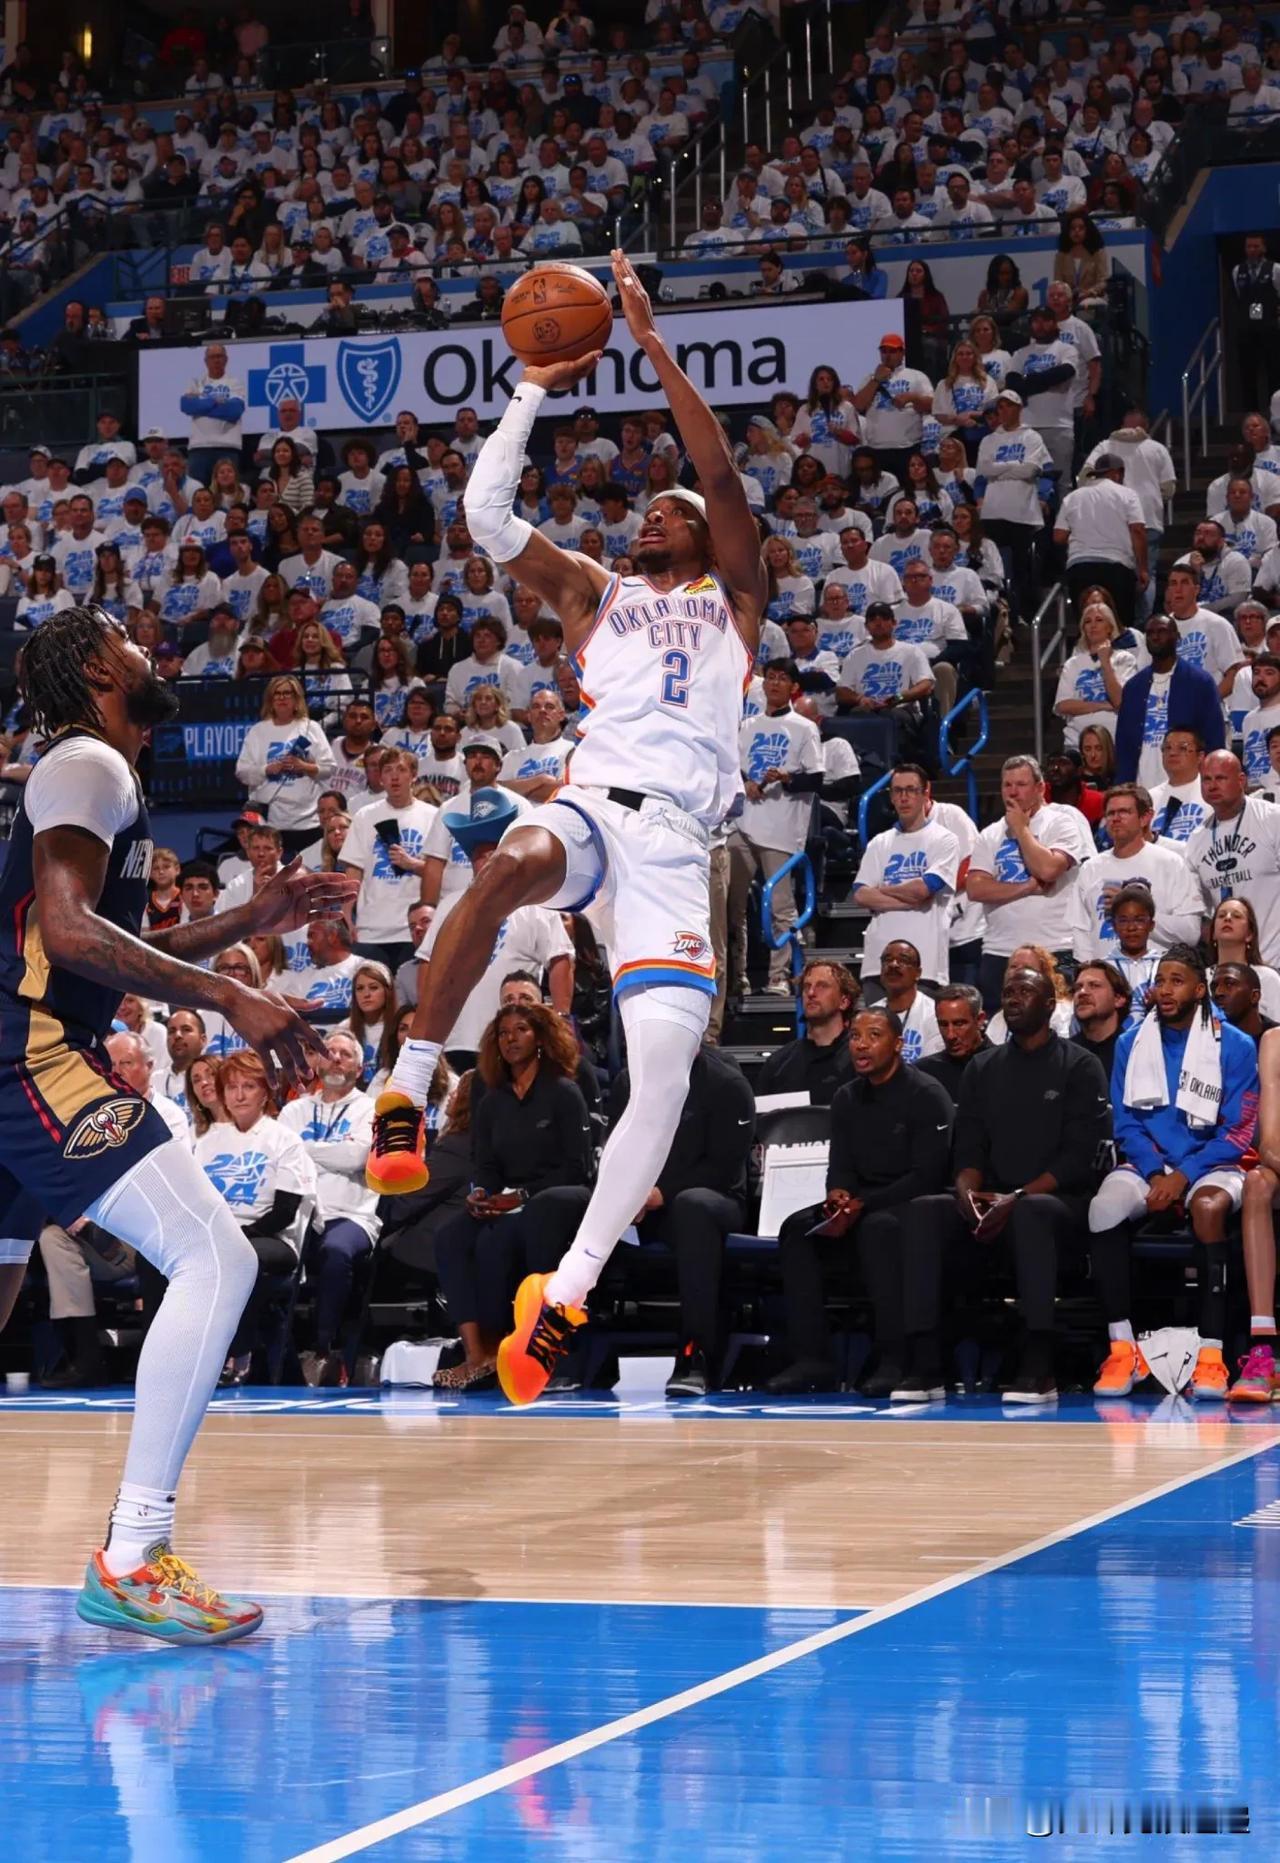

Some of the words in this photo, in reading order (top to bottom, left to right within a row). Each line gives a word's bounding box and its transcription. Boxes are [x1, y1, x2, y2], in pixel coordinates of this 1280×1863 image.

[647, 619, 702, 650] CITY
[660, 648, 692, 708] 2
[185, 725, 250, 758] PLAYOF
[1201, 833, 1257, 867] THUNDER
